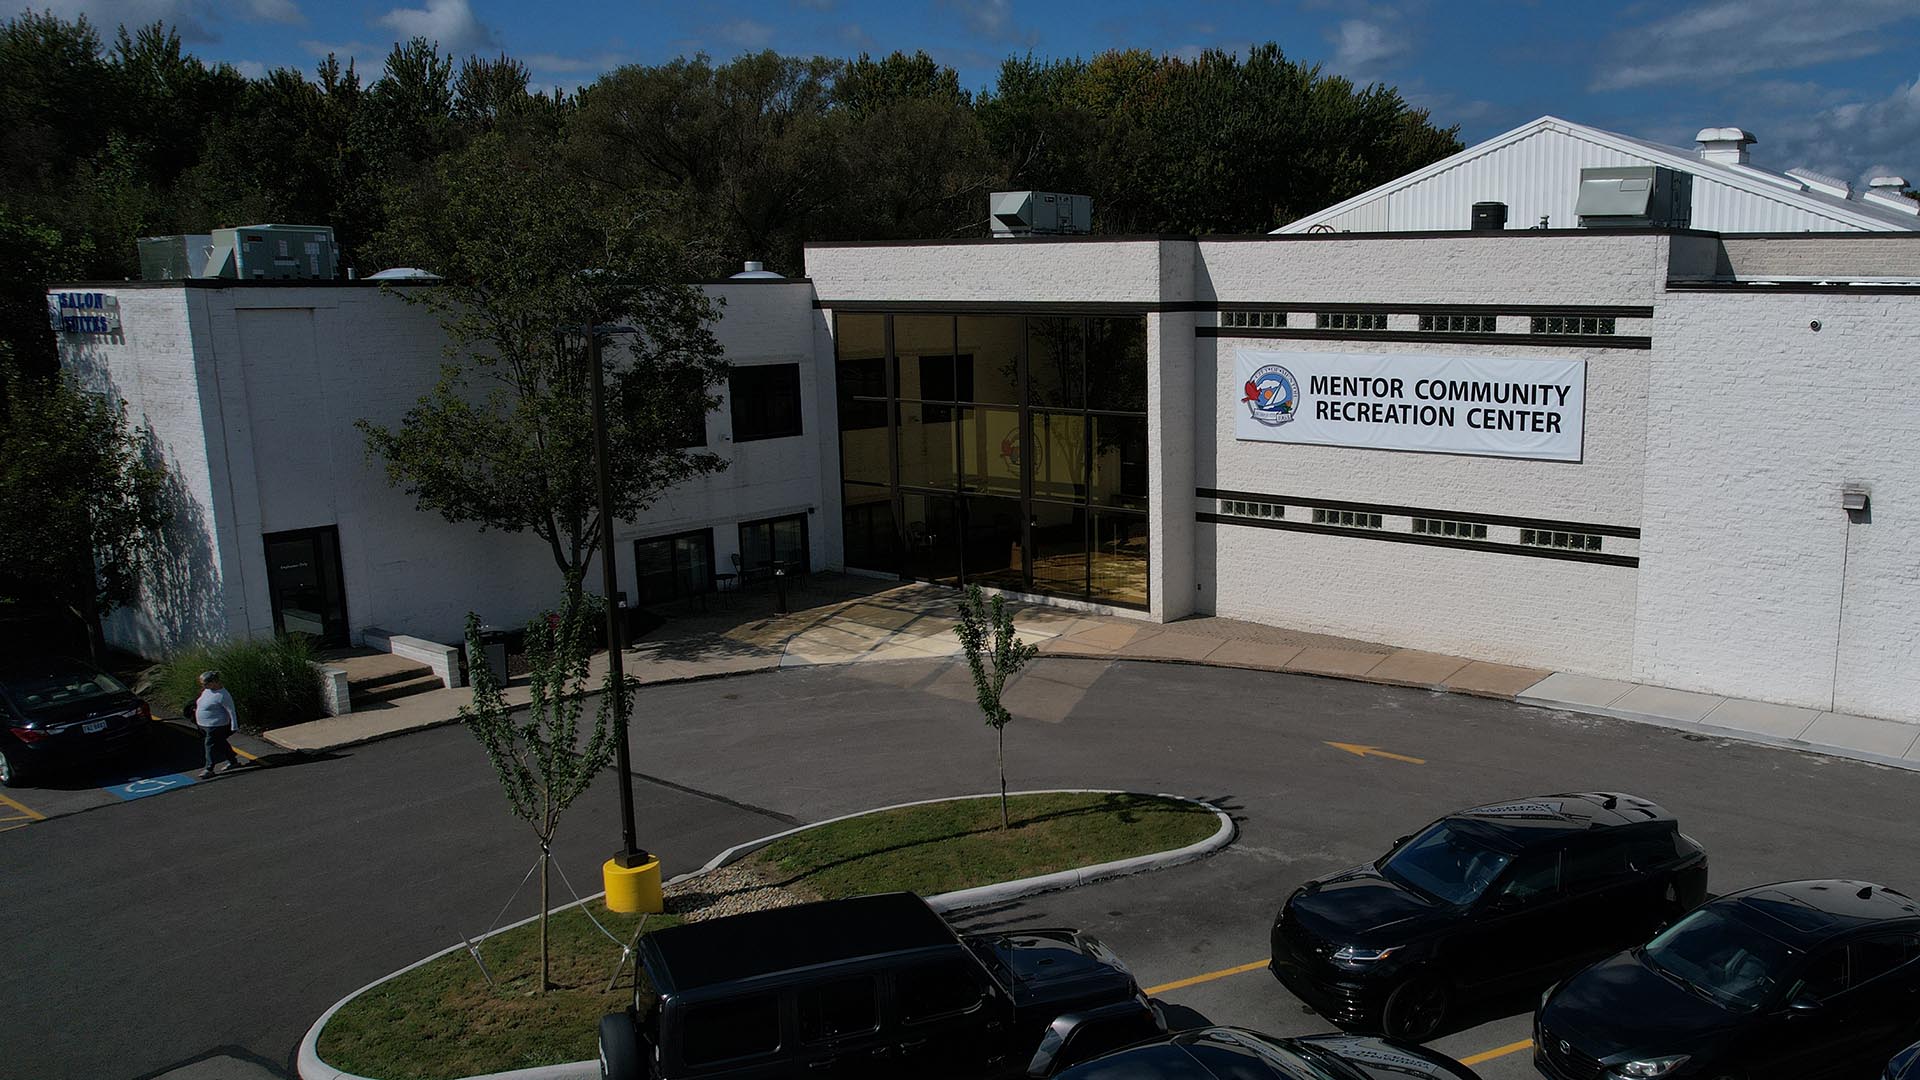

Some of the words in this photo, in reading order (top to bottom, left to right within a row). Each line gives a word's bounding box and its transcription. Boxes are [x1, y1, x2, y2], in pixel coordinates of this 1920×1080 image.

[60, 293, 103, 308] SALON
[64, 316, 108, 333] SUITES
[1310, 375, 1404, 399] MENTOR
[1414, 379, 1572, 407] COMMUNITY
[1316, 400, 1455, 427] RECREATION
[1466, 407, 1562, 434] CENTER
